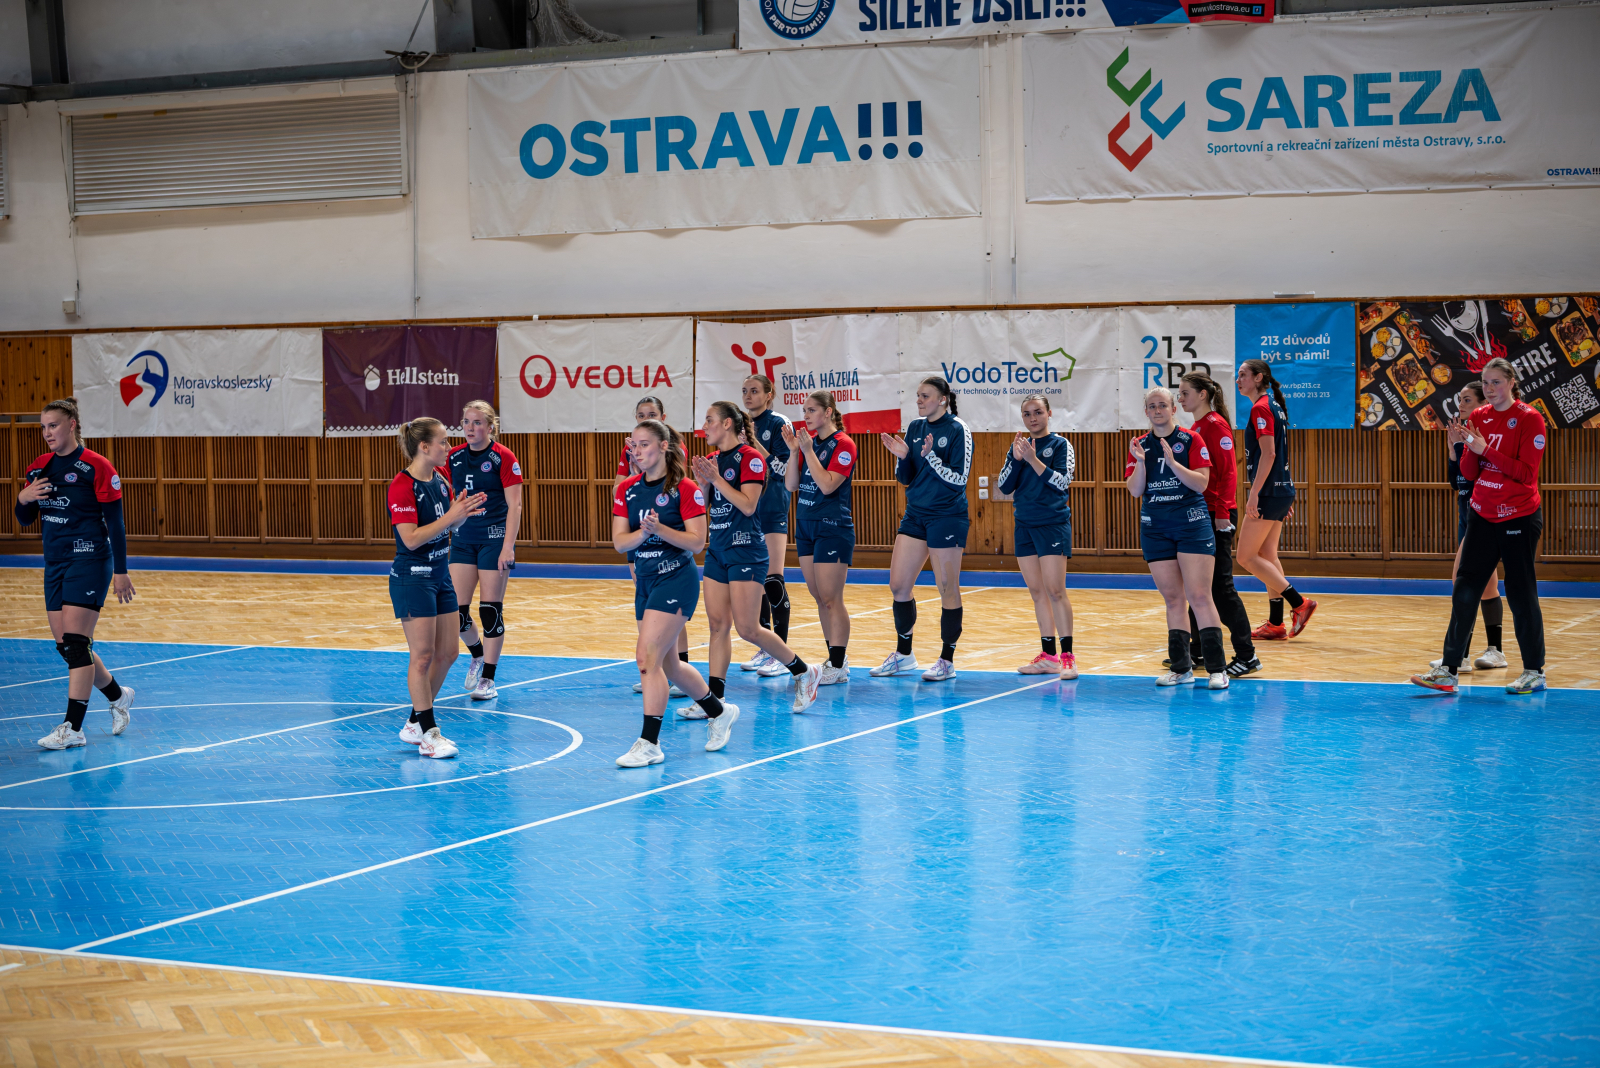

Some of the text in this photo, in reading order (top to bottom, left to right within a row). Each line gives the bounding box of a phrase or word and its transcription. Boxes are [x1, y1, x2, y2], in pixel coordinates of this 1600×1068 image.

[769, 14, 786, 32] PER
[785, 25, 798, 35] TO
[1205, 68, 1502, 133] SAREZA
[519, 100, 924, 180] OSTRAVA!!!
[1207, 135, 1506, 156] Sportovní a rekreační zařízení města Ostravy, s.r.o.
[1140, 335, 1198, 359] 213
[1260, 332, 1331, 346] 213 důvodů
[1260, 348, 1330, 363] být s námi!
[386, 366, 460, 386] Hellstein
[562, 364, 673, 389] VEOLIA
[781, 367, 860, 391] ČESKÁ HÁZENÁ
[941, 361, 1058, 384] VodoTech
[173, 374, 272, 392] Moravskoslezský
[963, 386, 1001, 396] technology
[1002, 387, 1008, 395] &
[1009, 386, 1043, 395] Customer
[1044, 386, 1062, 395] Care
[173, 390, 195, 408] kraj
[1292, 391, 1306, 399] 800
[1379, 381, 1410, 425] coalfire.cz
[1157, 458, 1166, 474] 7
[465, 474, 474, 490] 5
